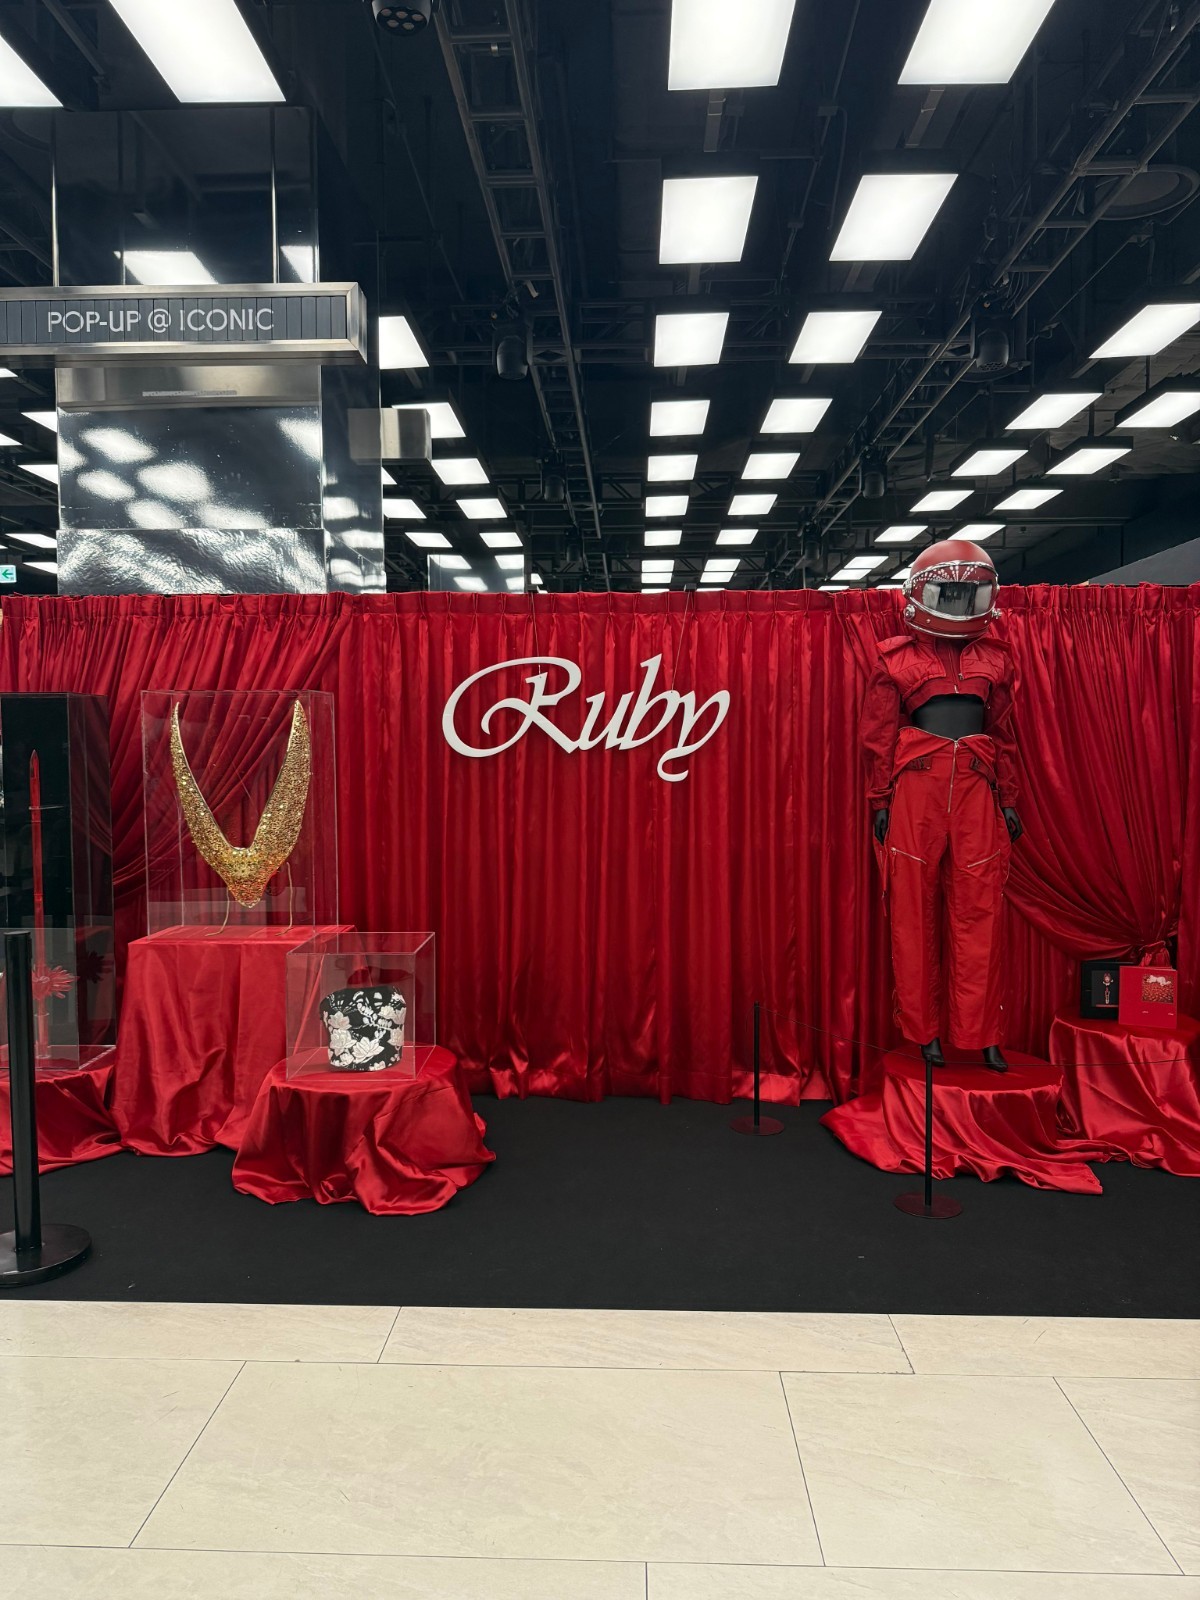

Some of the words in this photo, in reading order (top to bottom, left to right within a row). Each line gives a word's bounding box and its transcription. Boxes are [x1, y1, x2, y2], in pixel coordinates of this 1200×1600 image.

[47, 310, 142, 333] POP-UP
[147, 308, 172, 334] @
[179, 308, 275, 332] ICONIC
[441, 653, 731, 783] Ruby
